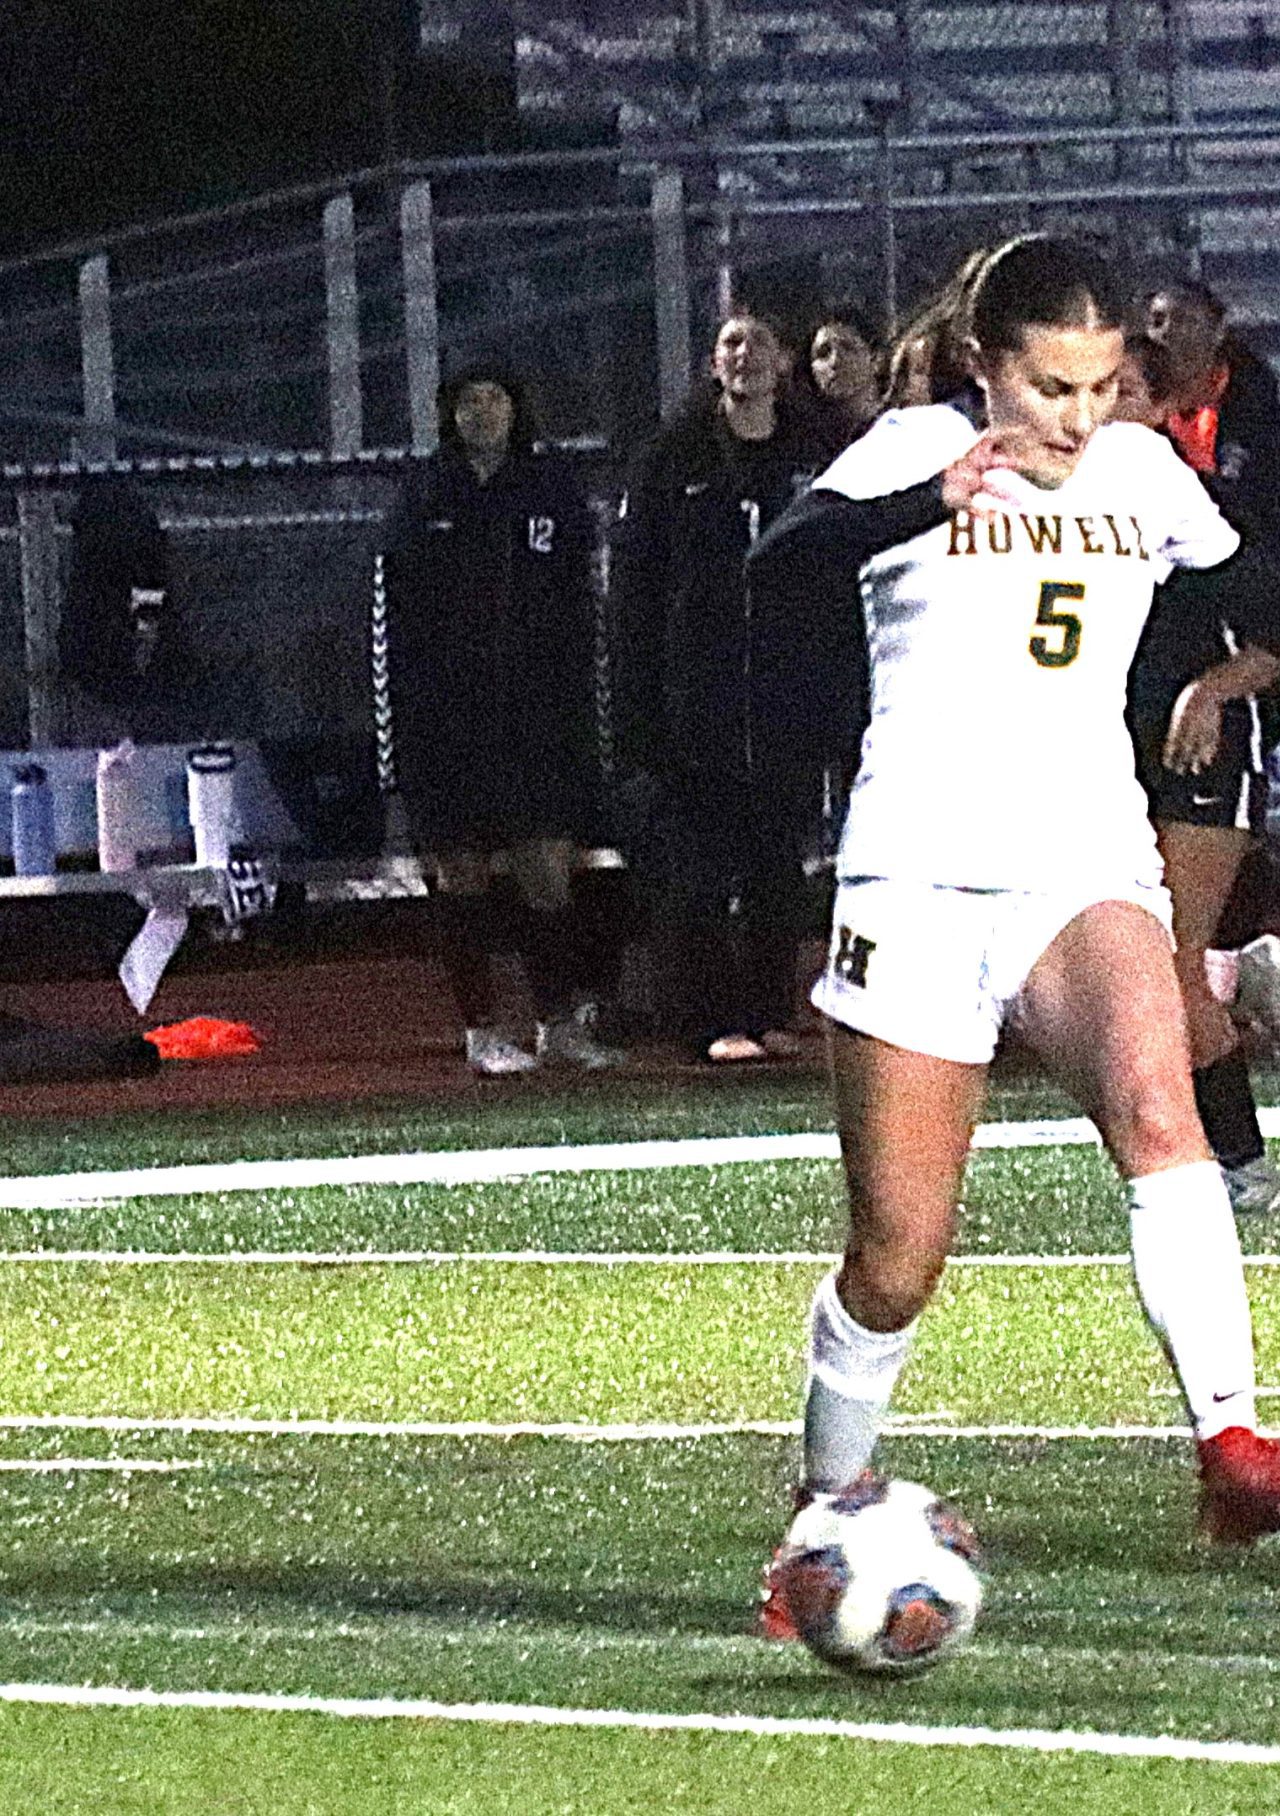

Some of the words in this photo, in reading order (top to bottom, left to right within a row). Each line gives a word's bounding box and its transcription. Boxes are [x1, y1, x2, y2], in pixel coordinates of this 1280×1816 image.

[528, 517, 554, 553] 12
[947, 508, 1150, 561] HOWELL
[1028, 578, 1086, 668] 5
